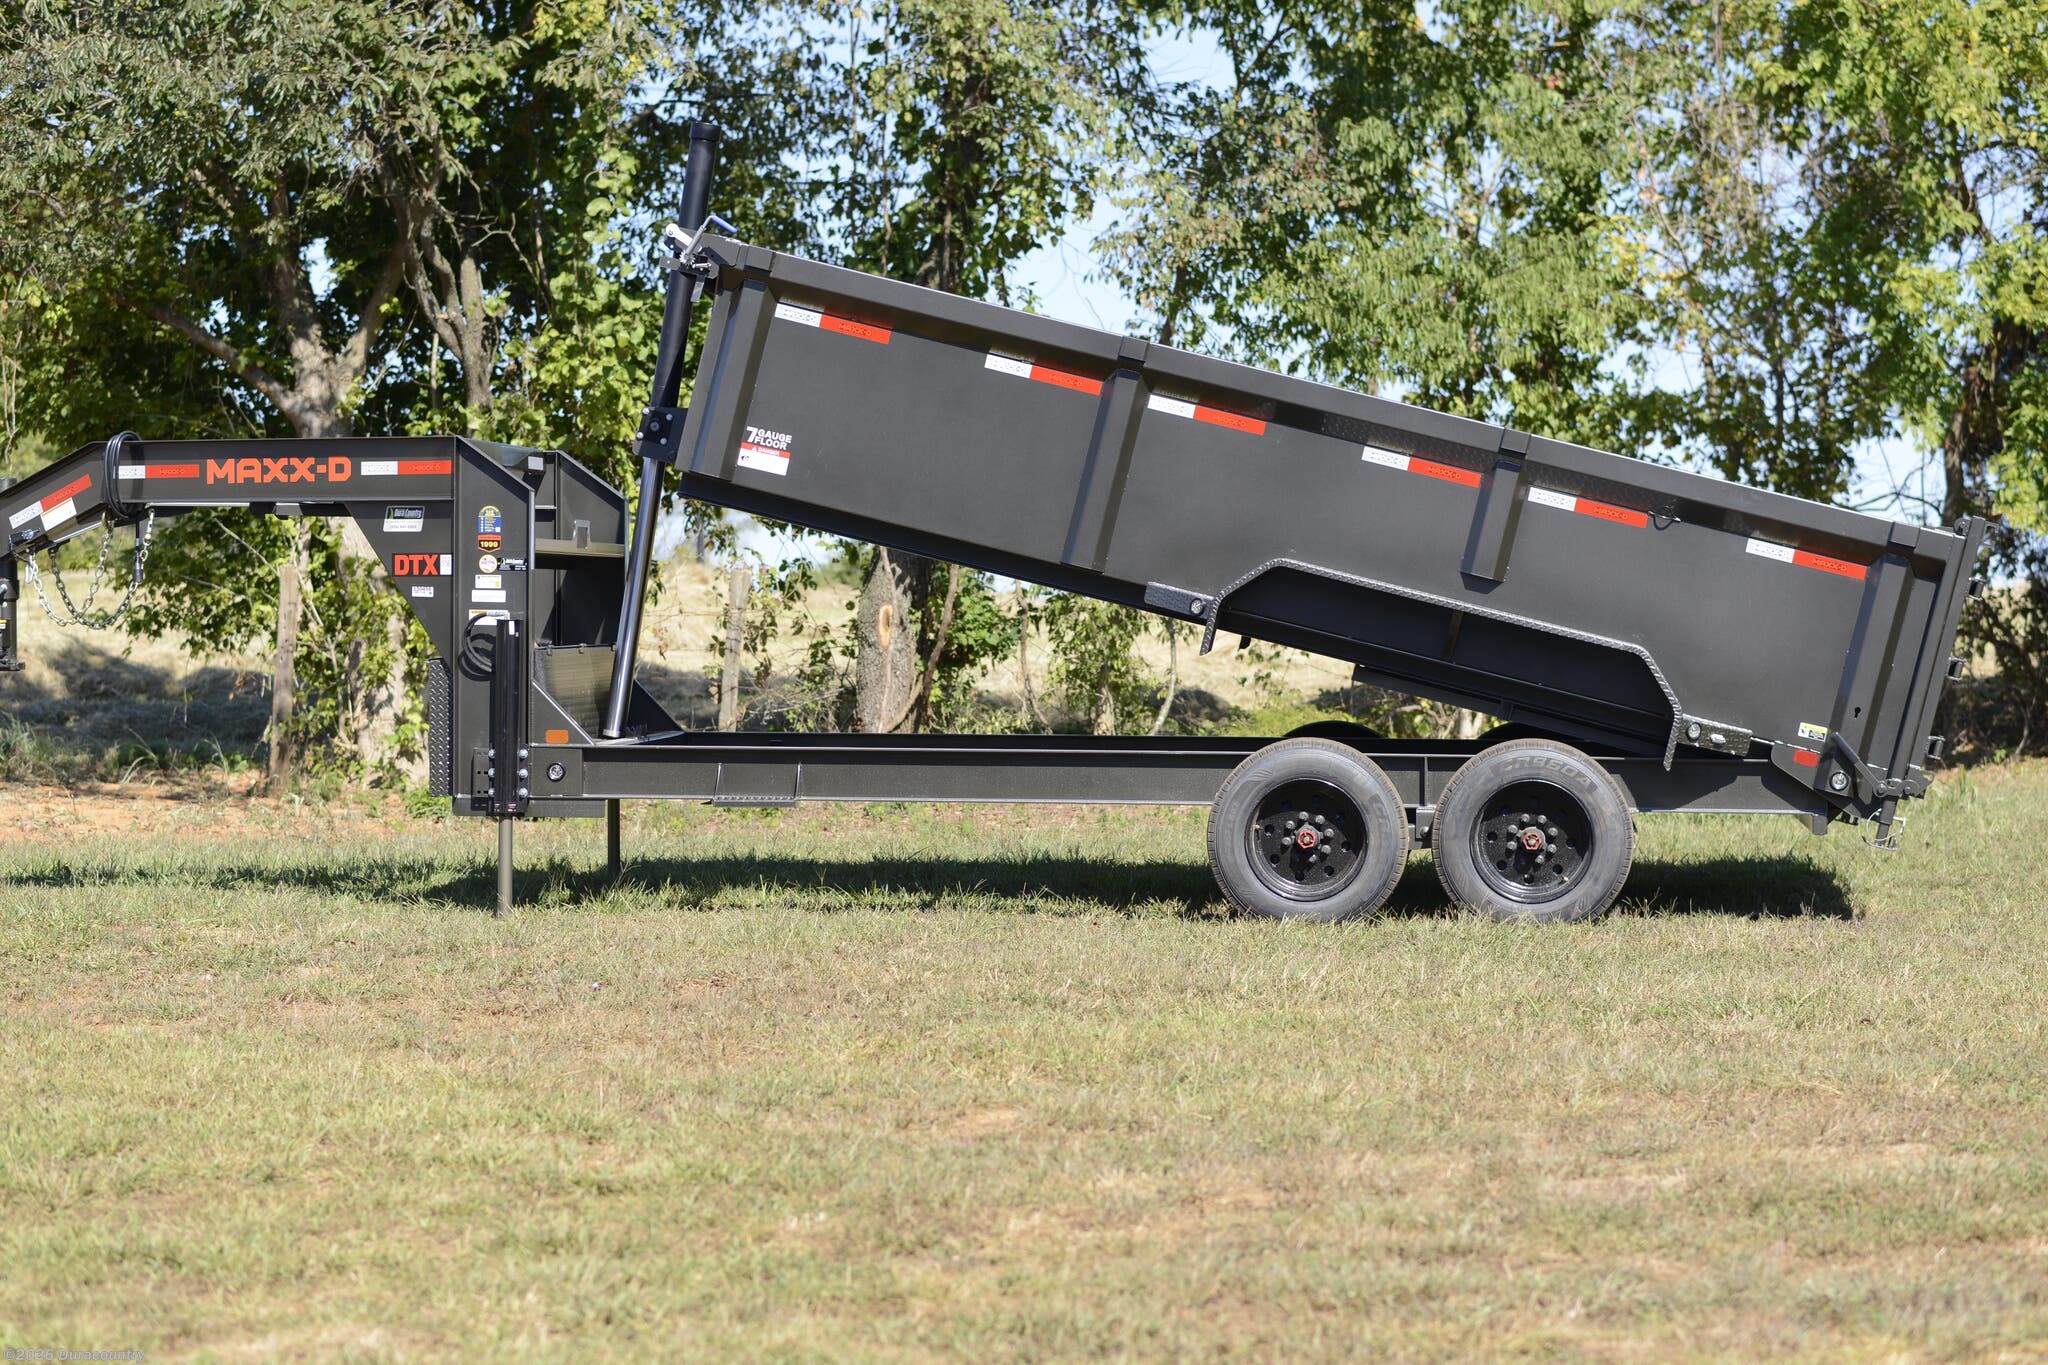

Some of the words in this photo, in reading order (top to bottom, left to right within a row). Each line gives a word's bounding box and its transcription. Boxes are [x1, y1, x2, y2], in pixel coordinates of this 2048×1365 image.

[838, 322, 872, 337] MAXX-D
[746, 425, 758, 443] 7
[757, 428, 793, 443] GAUGE
[754, 435, 788, 450] FLOOR
[206, 456, 352, 485] MAXX-D
[1427, 465, 1462, 480] MAXX-D
[1593, 505, 1628, 520] MAXX-D
[394, 554, 439, 576] DTX
[1812, 557, 1848, 572] MAXX-D
